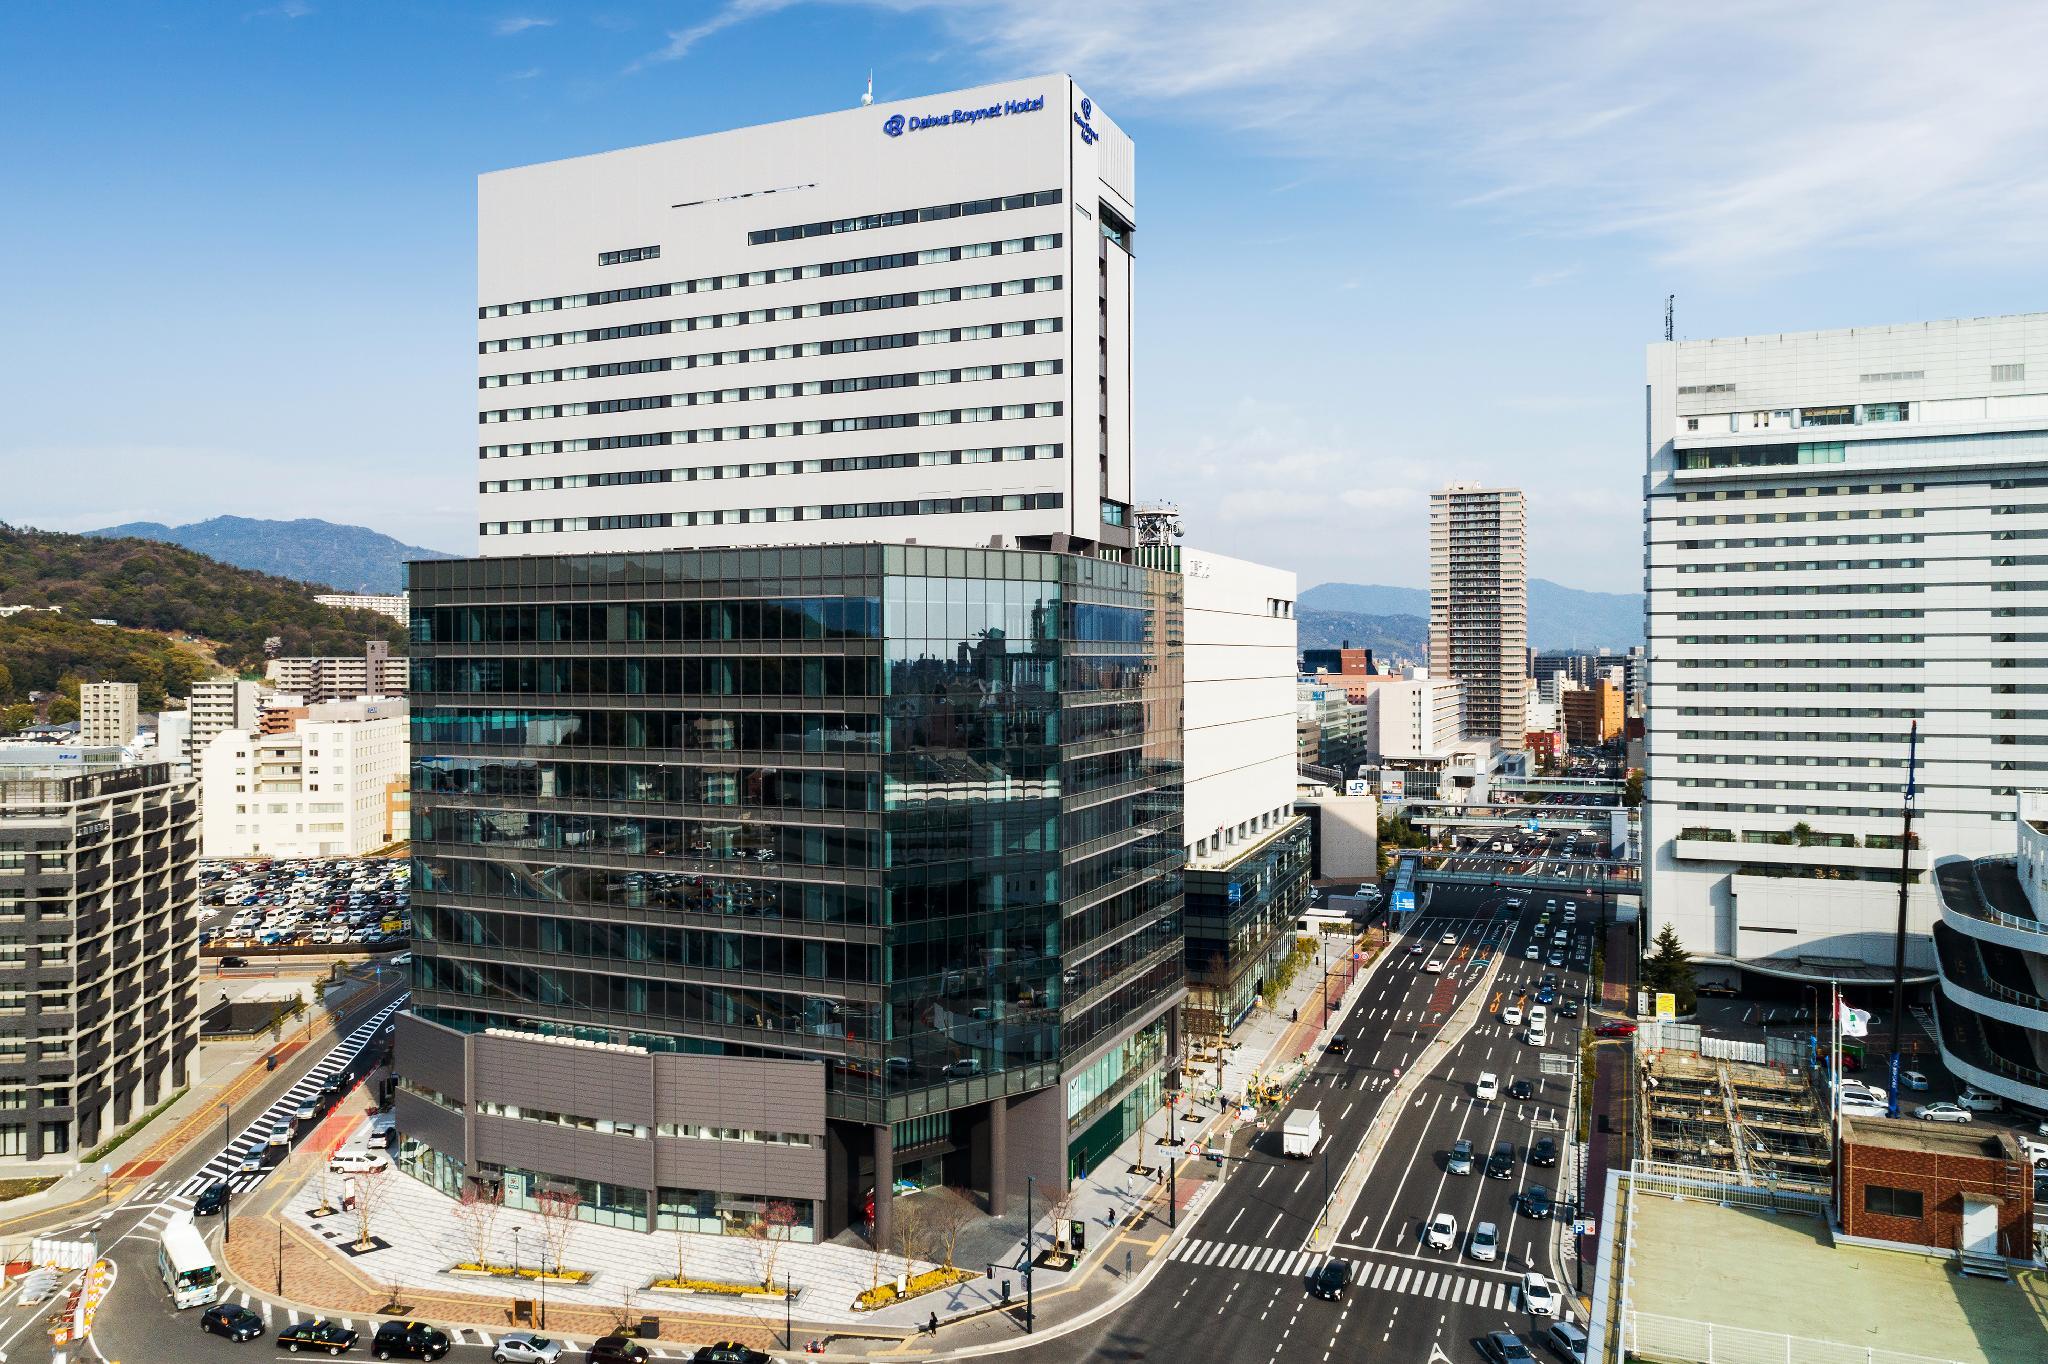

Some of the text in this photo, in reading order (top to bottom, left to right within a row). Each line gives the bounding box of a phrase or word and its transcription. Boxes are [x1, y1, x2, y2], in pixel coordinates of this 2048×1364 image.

[908, 114, 949, 131] Daiwa
[952, 102, 1002, 125] Roynet
[1004, 94, 1044, 115] Hotel
[1349, 782, 1364, 791] JR
[1575, 1225, 1584, 1234] P
